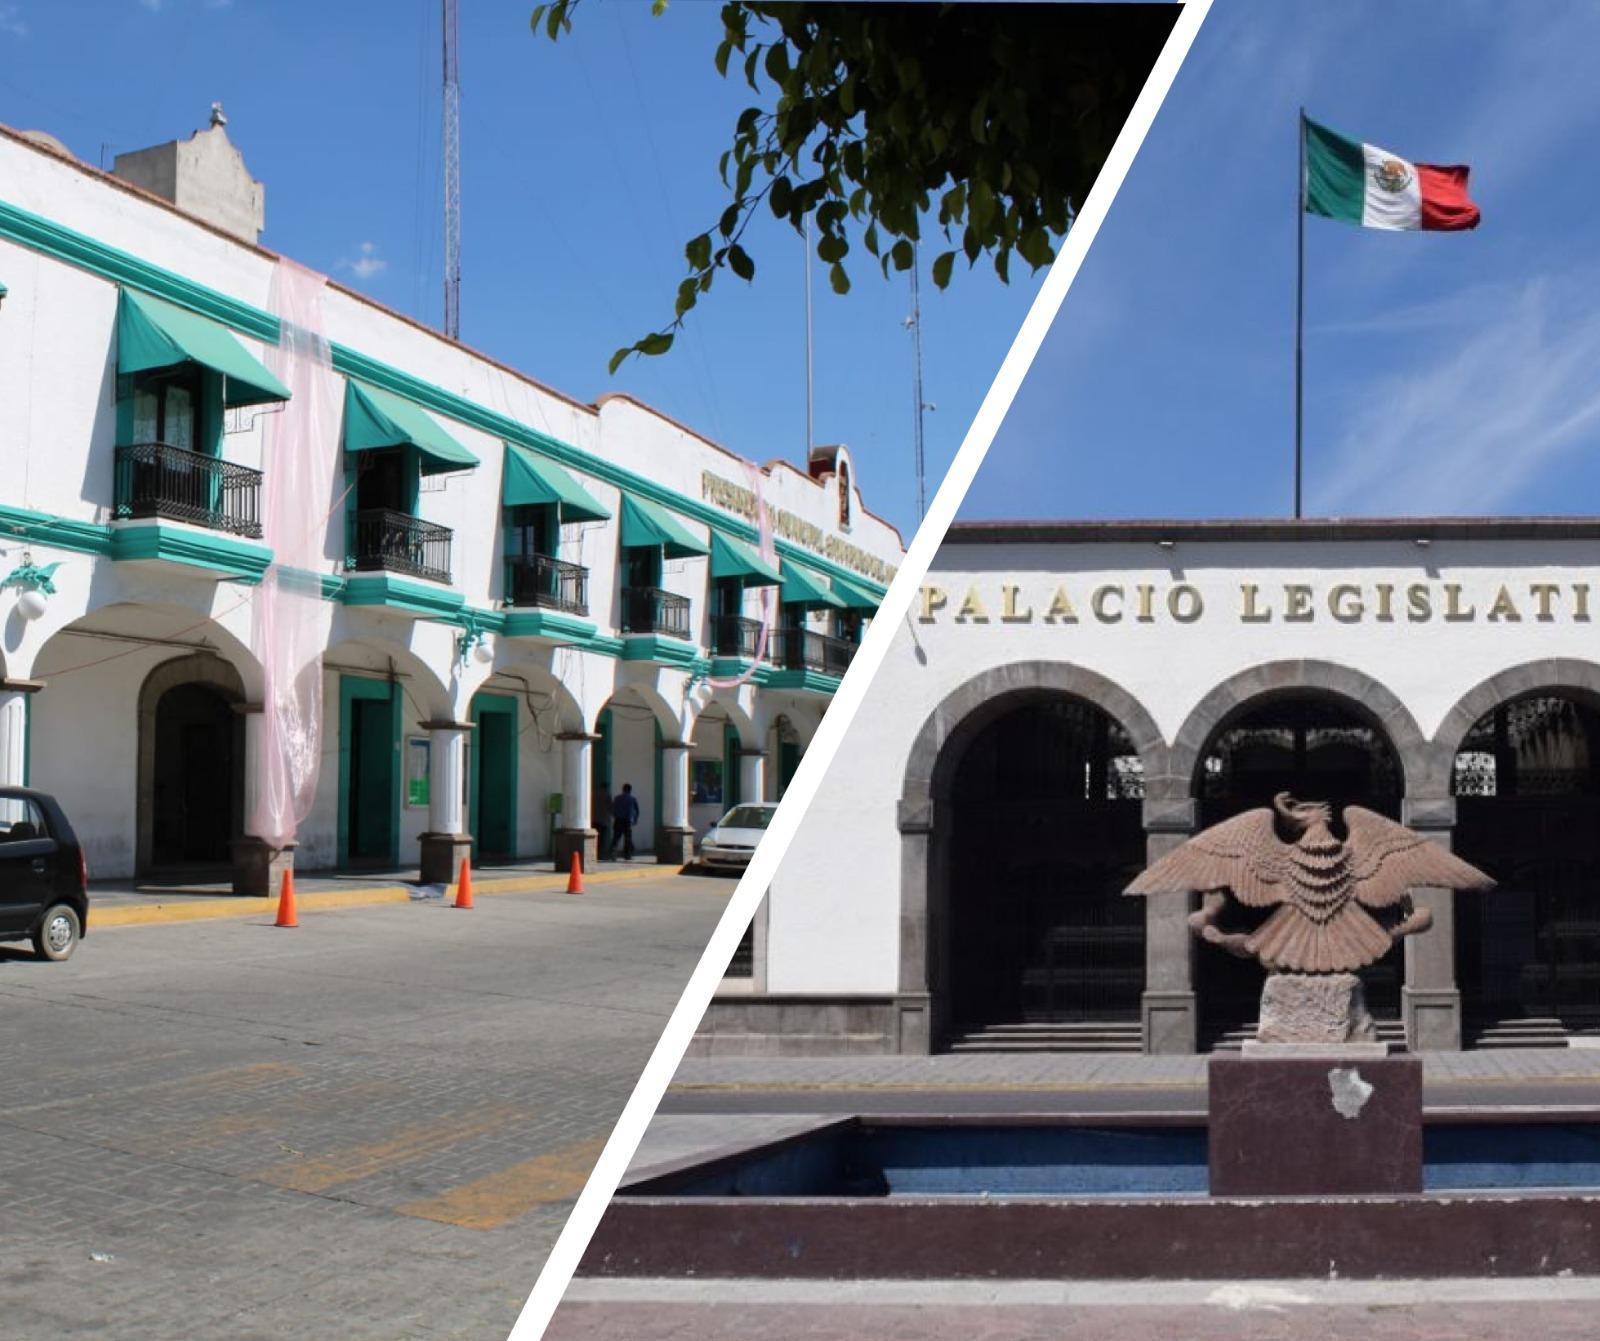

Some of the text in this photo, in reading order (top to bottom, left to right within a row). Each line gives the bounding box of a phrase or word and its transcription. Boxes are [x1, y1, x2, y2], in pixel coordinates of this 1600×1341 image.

[702, 469, 776, 534] PRESIDENIA
[918, 583, 1592, 624] PALACIO LEGISLATI
